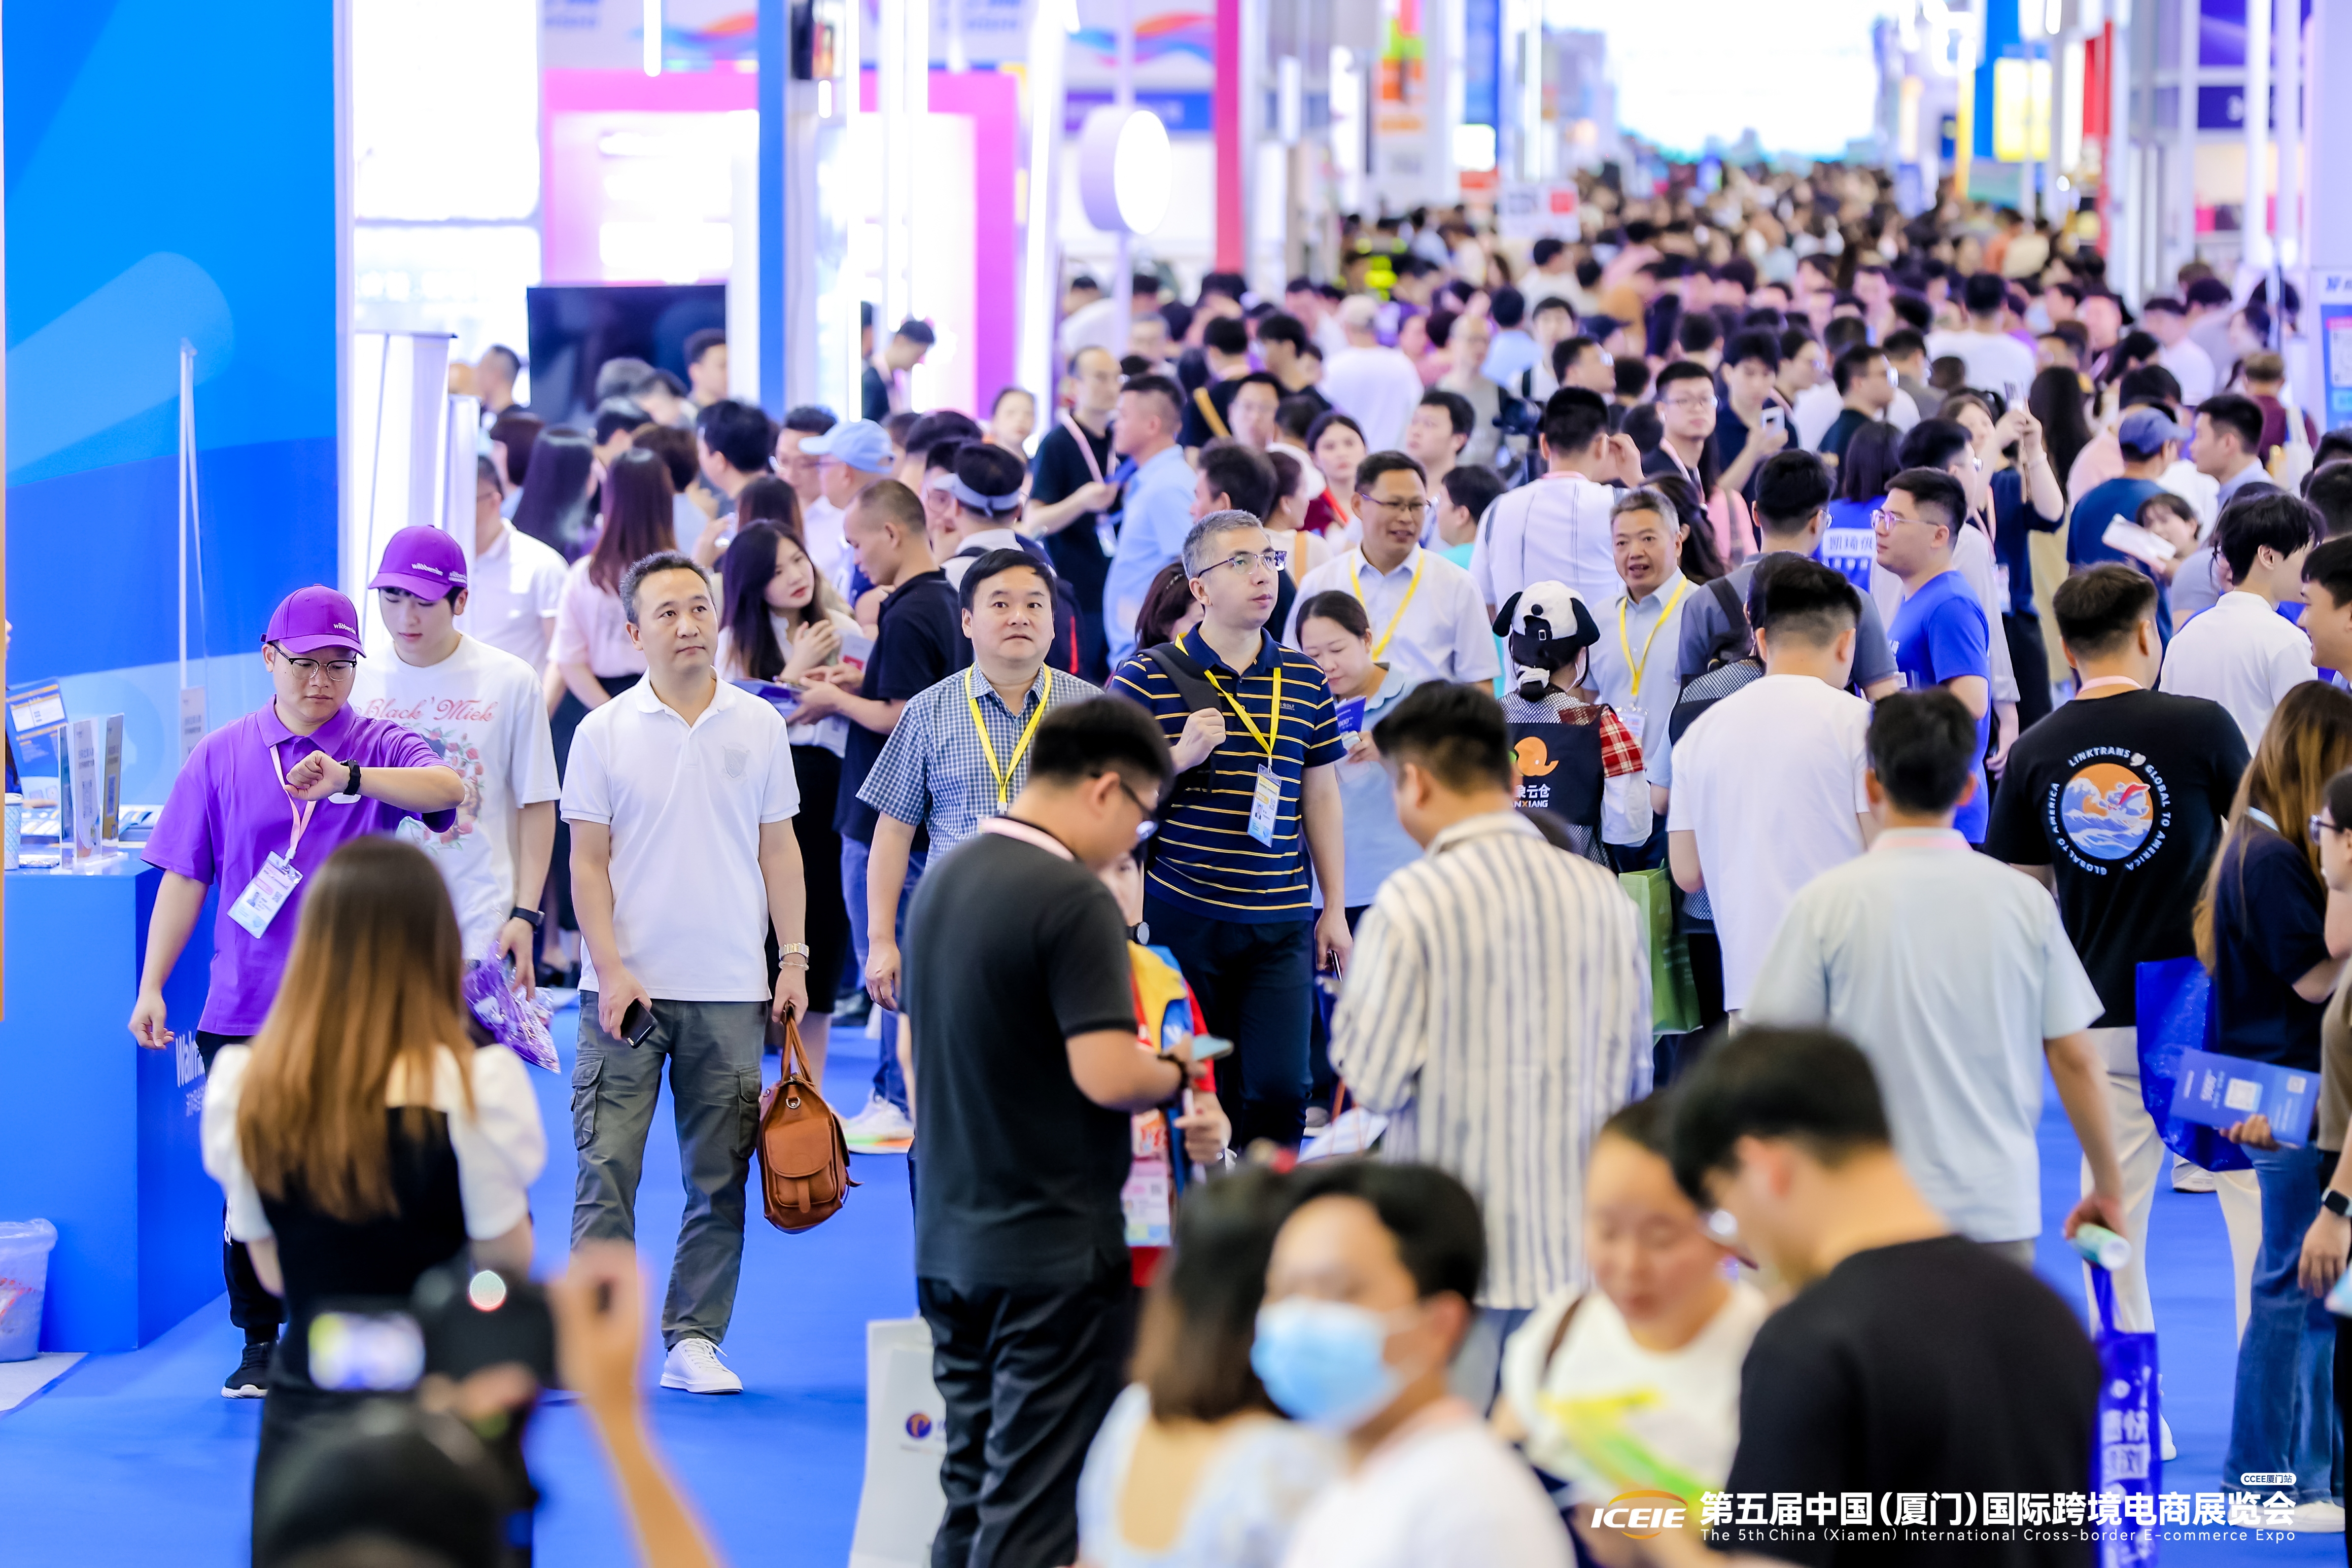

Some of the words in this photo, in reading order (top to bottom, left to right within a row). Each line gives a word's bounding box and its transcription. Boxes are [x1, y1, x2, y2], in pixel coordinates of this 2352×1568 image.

[2068, 746, 2131, 767] LINKTRANS
[2145, 764, 2170, 807] GLOBAL
[2048, 783, 2060, 833] AMERICA
[2160, 812, 2171, 827] TO
[2057, 838, 2069, 852] TO
[2125, 830, 2165, 870] AMERICA
[2068, 850, 2107, 875] GLOBAL
